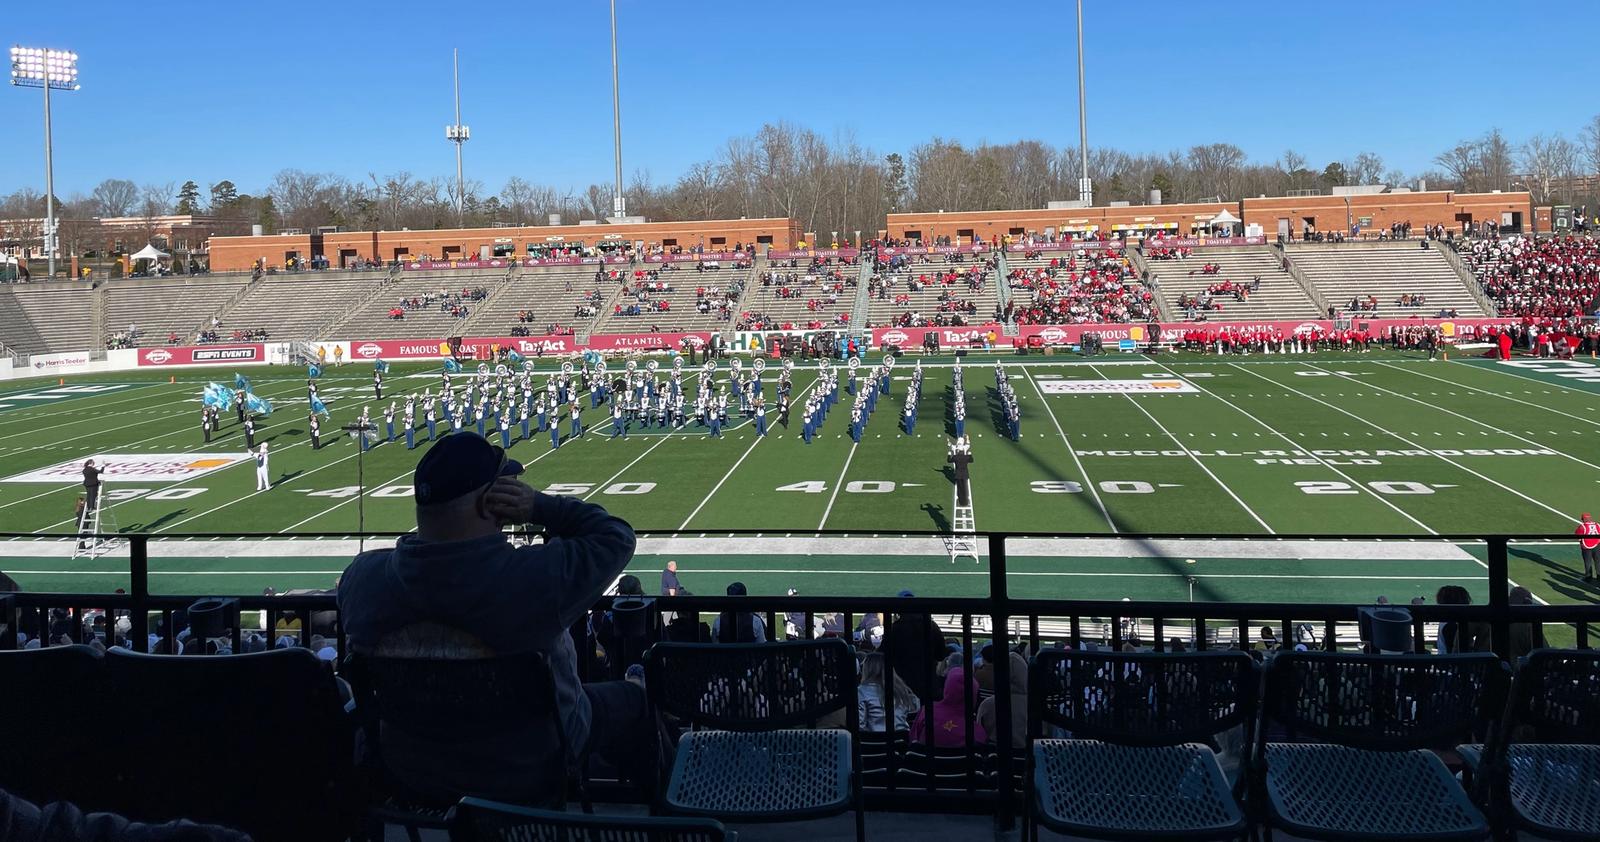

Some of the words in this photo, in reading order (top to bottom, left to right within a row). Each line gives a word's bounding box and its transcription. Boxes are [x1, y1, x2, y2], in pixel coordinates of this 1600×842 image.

[1084, 329, 1128, 339] MOUS
[518, 339, 566, 352] TaxAct
[615, 337, 663, 346] ATLANTIS
[221, 349, 251, 358] EVENTS
[400, 345, 438, 354] FAMOUS
[45, 358, 63, 367] Harris
[64, 357, 86, 365] Teeter
[541, 482, 658, 495] 50
[775, 480, 896, 494] 40
[1030, 480, 1156, 494] 30
[1293, 481, 1436, 494] 20
